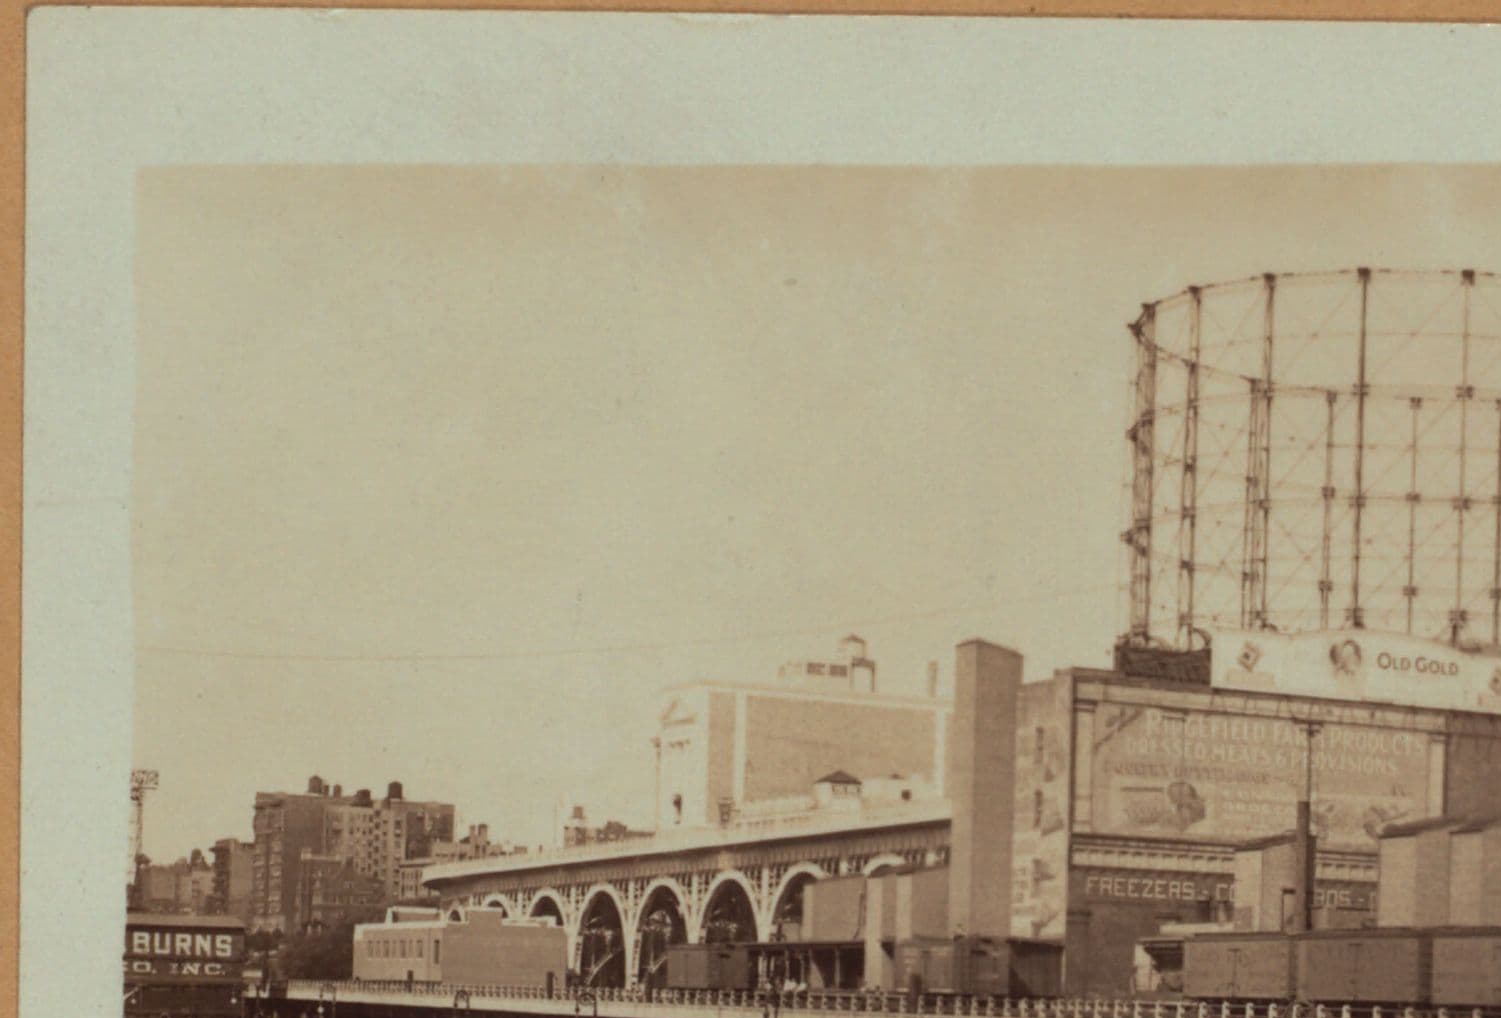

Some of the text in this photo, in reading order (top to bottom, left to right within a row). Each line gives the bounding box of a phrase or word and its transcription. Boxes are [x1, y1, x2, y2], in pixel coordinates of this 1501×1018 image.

[1376, 651, 1459, 676] OLD GOLD
[1086, 875, 1196, 901] FREEZERS
[132, 931, 233, 958] BURNS
